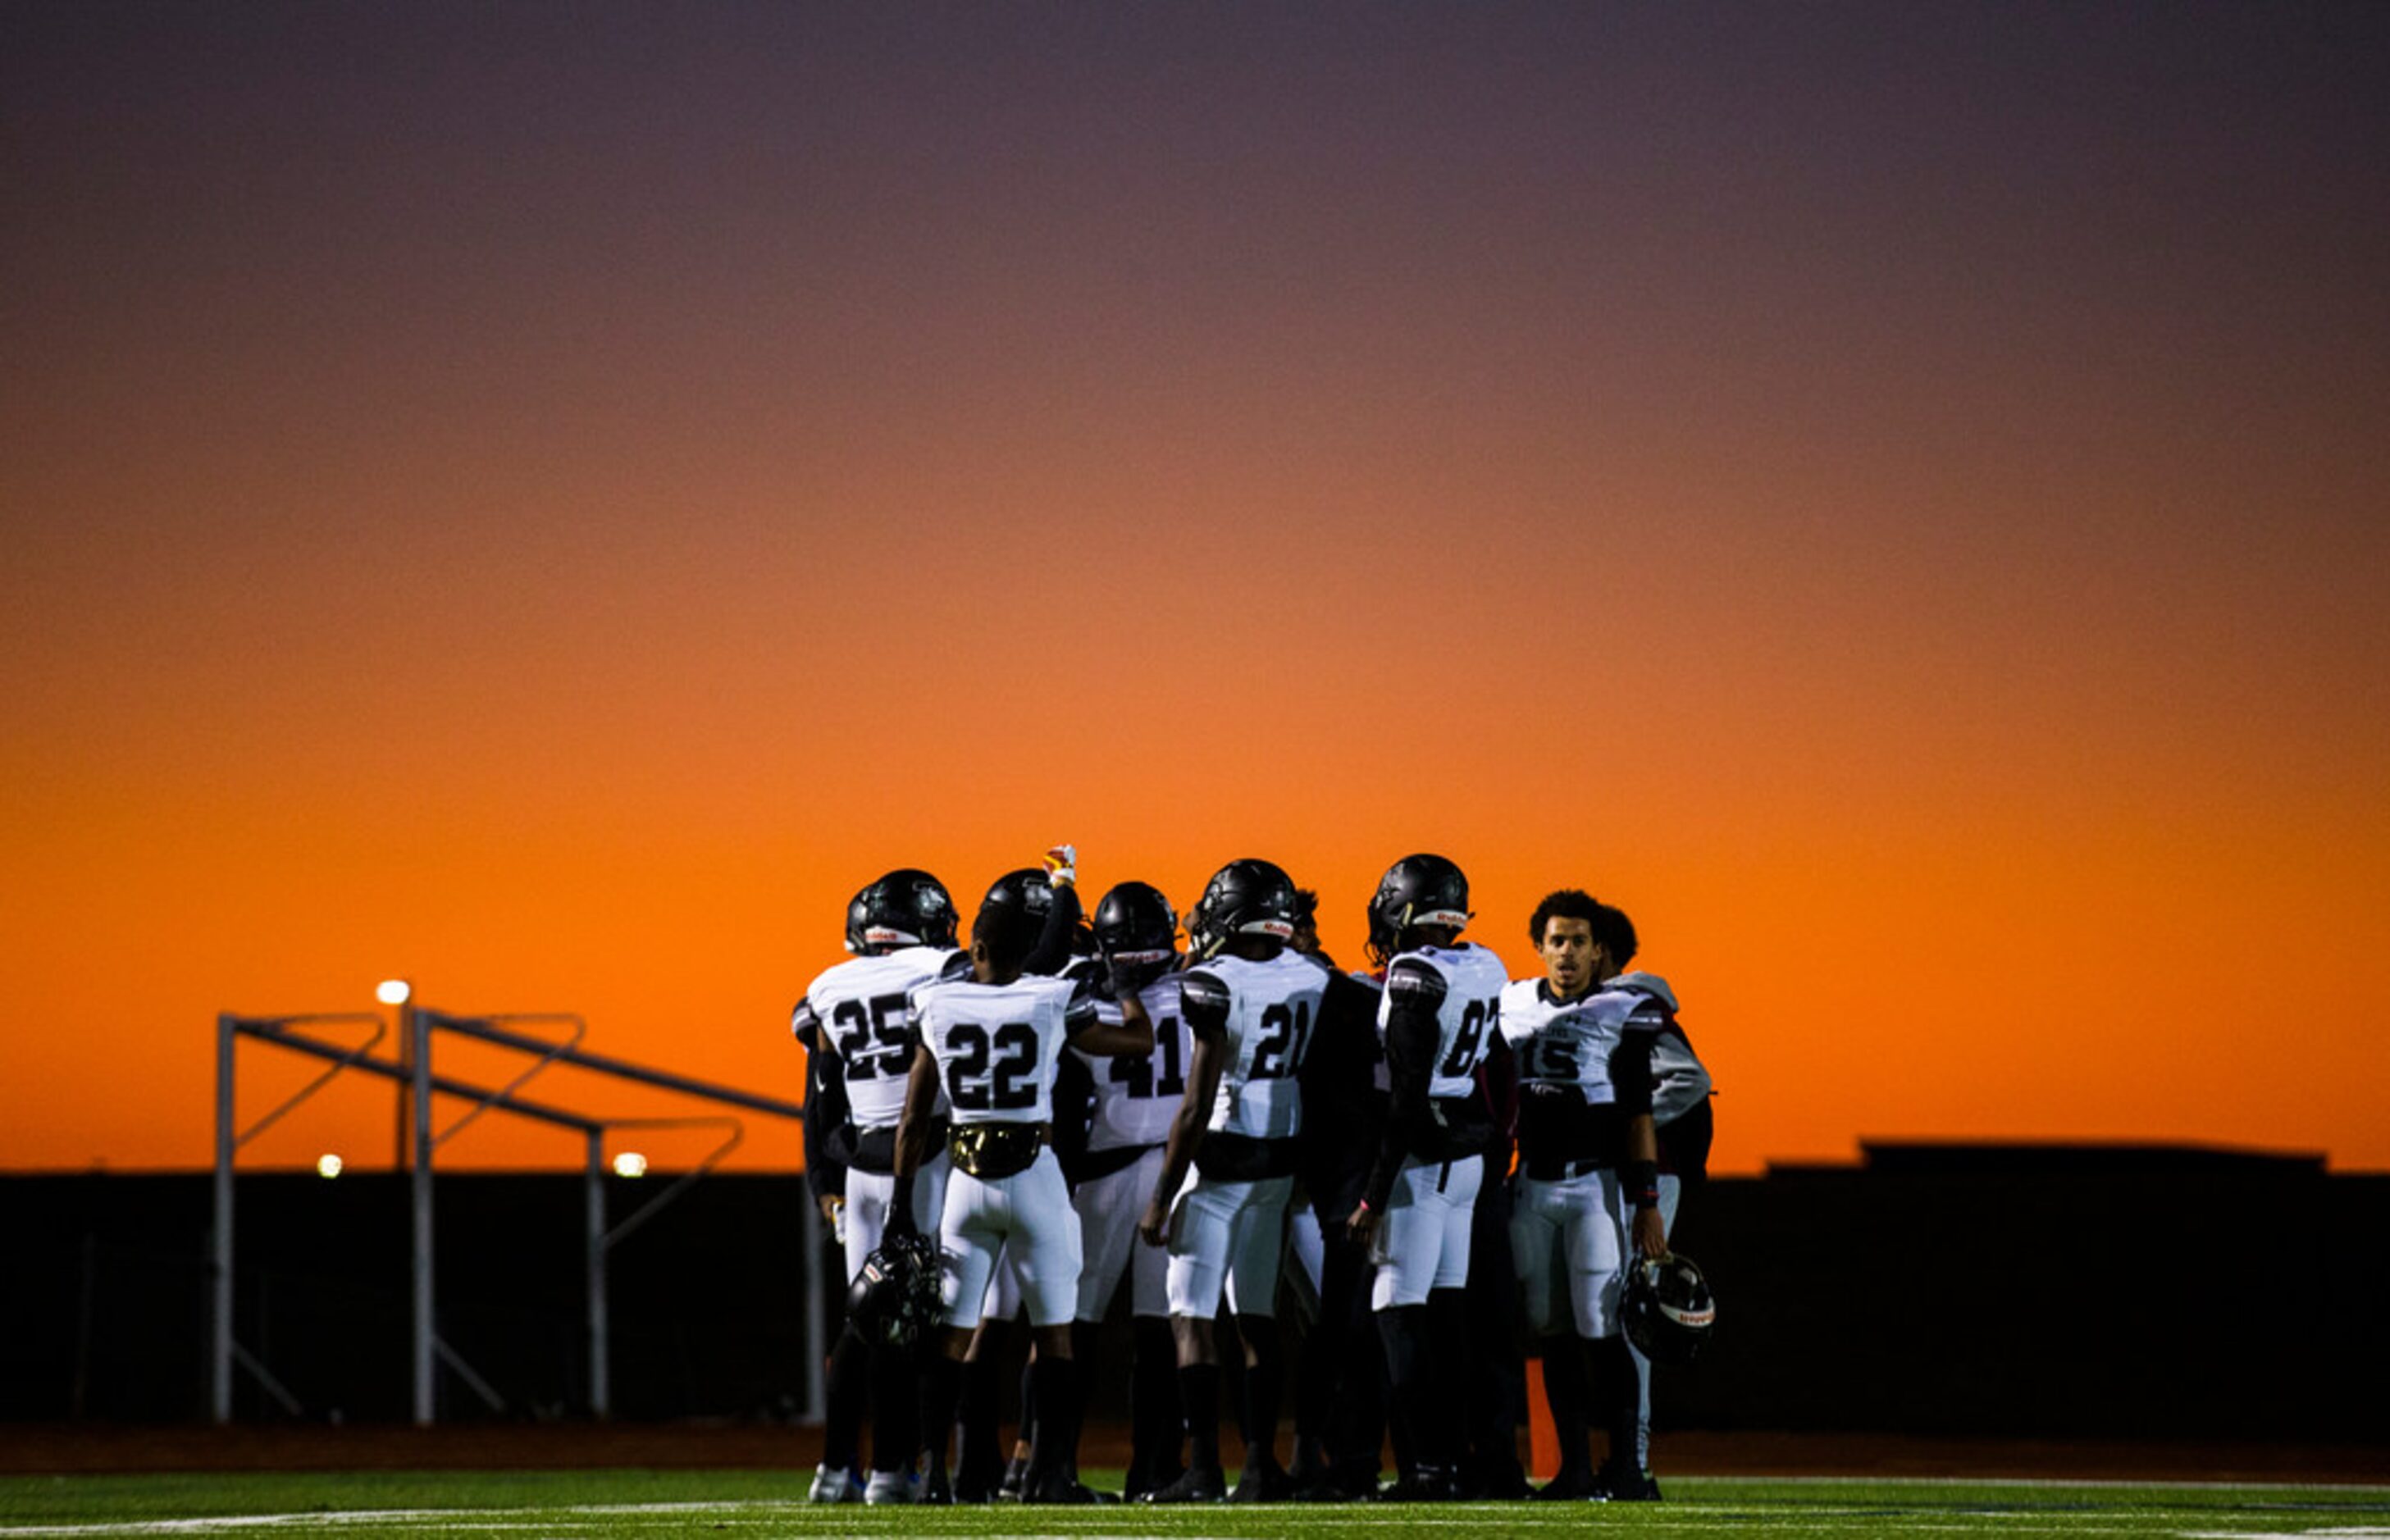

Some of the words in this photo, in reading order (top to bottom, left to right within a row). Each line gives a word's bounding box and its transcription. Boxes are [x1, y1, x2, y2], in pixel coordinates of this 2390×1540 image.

[832, 991, 917, 1081] 25
[946, 1023, 1038, 1109] 22
[1247, 1000, 1310, 1080] 21
[1523, 1034, 1579, 1079] 15
